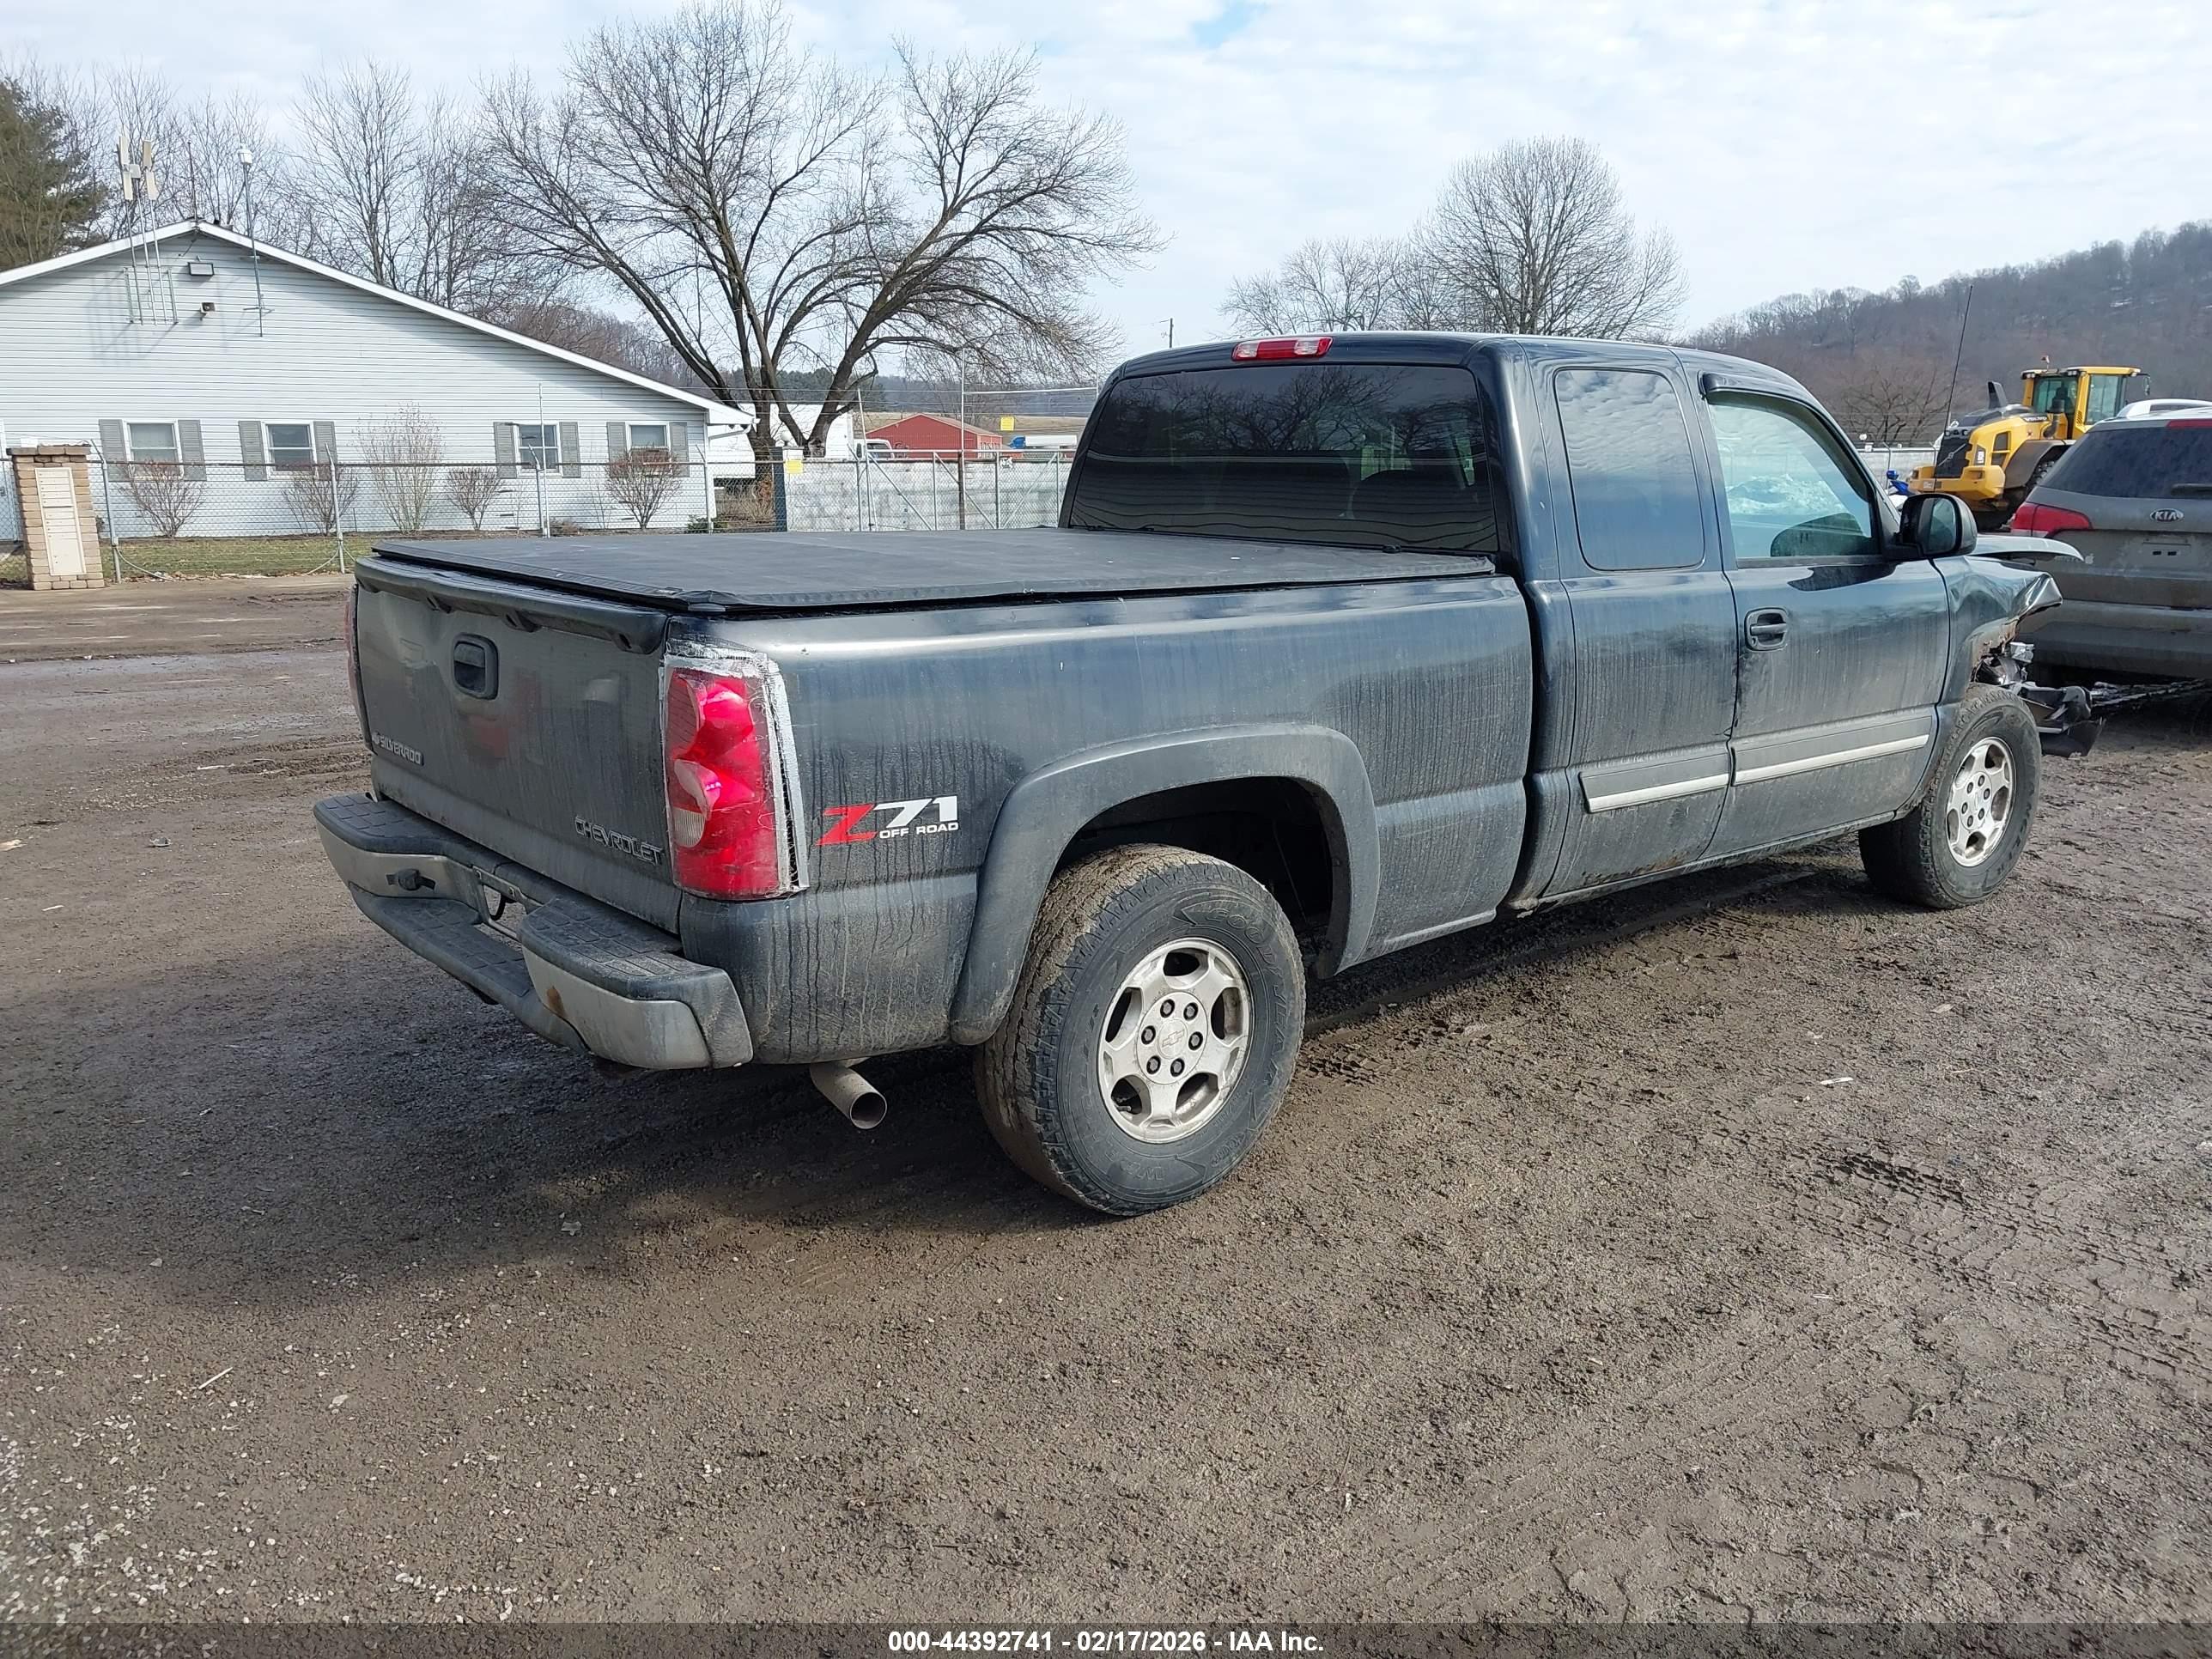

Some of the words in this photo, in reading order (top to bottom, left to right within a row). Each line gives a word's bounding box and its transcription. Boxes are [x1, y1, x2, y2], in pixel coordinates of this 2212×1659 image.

[2154, 511, 2179, 521] KIA
[380, 734, 422, 764] SILVERADO
[815, 795, 958, 846] Z71
[878, 827, 909, 839] OFF
[915, 822, 959, 835] ROAD
[574, 816, 663, 866] CHEVROLET
